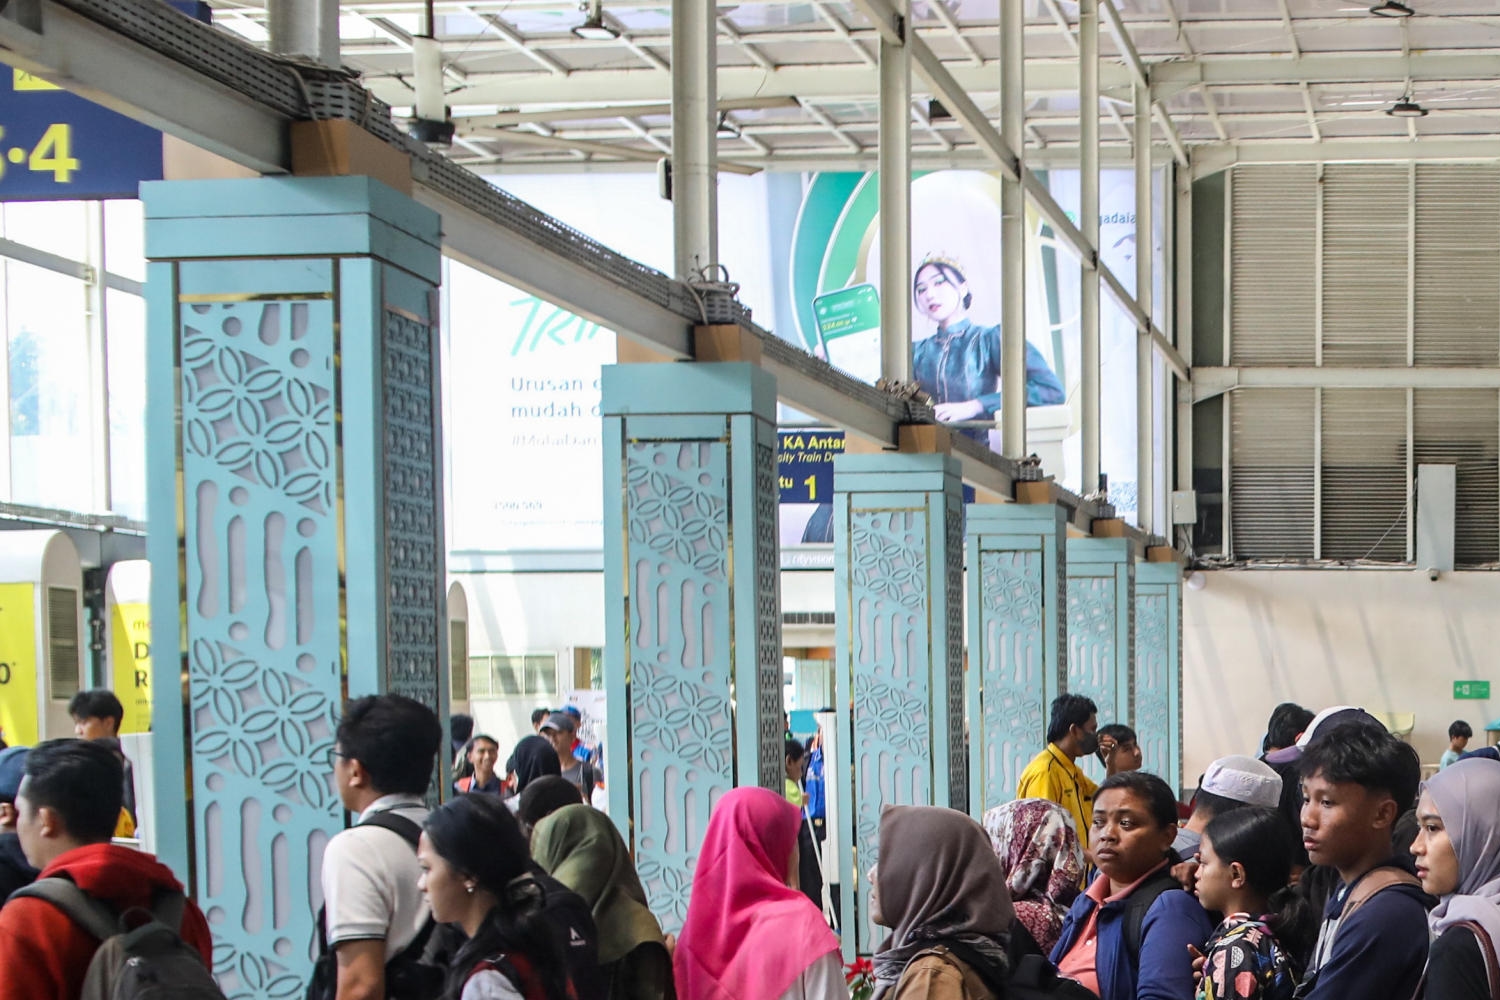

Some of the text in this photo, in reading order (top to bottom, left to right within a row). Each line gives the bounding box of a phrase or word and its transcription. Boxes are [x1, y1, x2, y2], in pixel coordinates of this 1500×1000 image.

[511, 377, 583, 391] Urusan
[511, 401, 581, 418] mudah
[784, 436, 805, 450] KA
[799, 451, 822, 463] Train
[804, 475, 817, 500] 1
